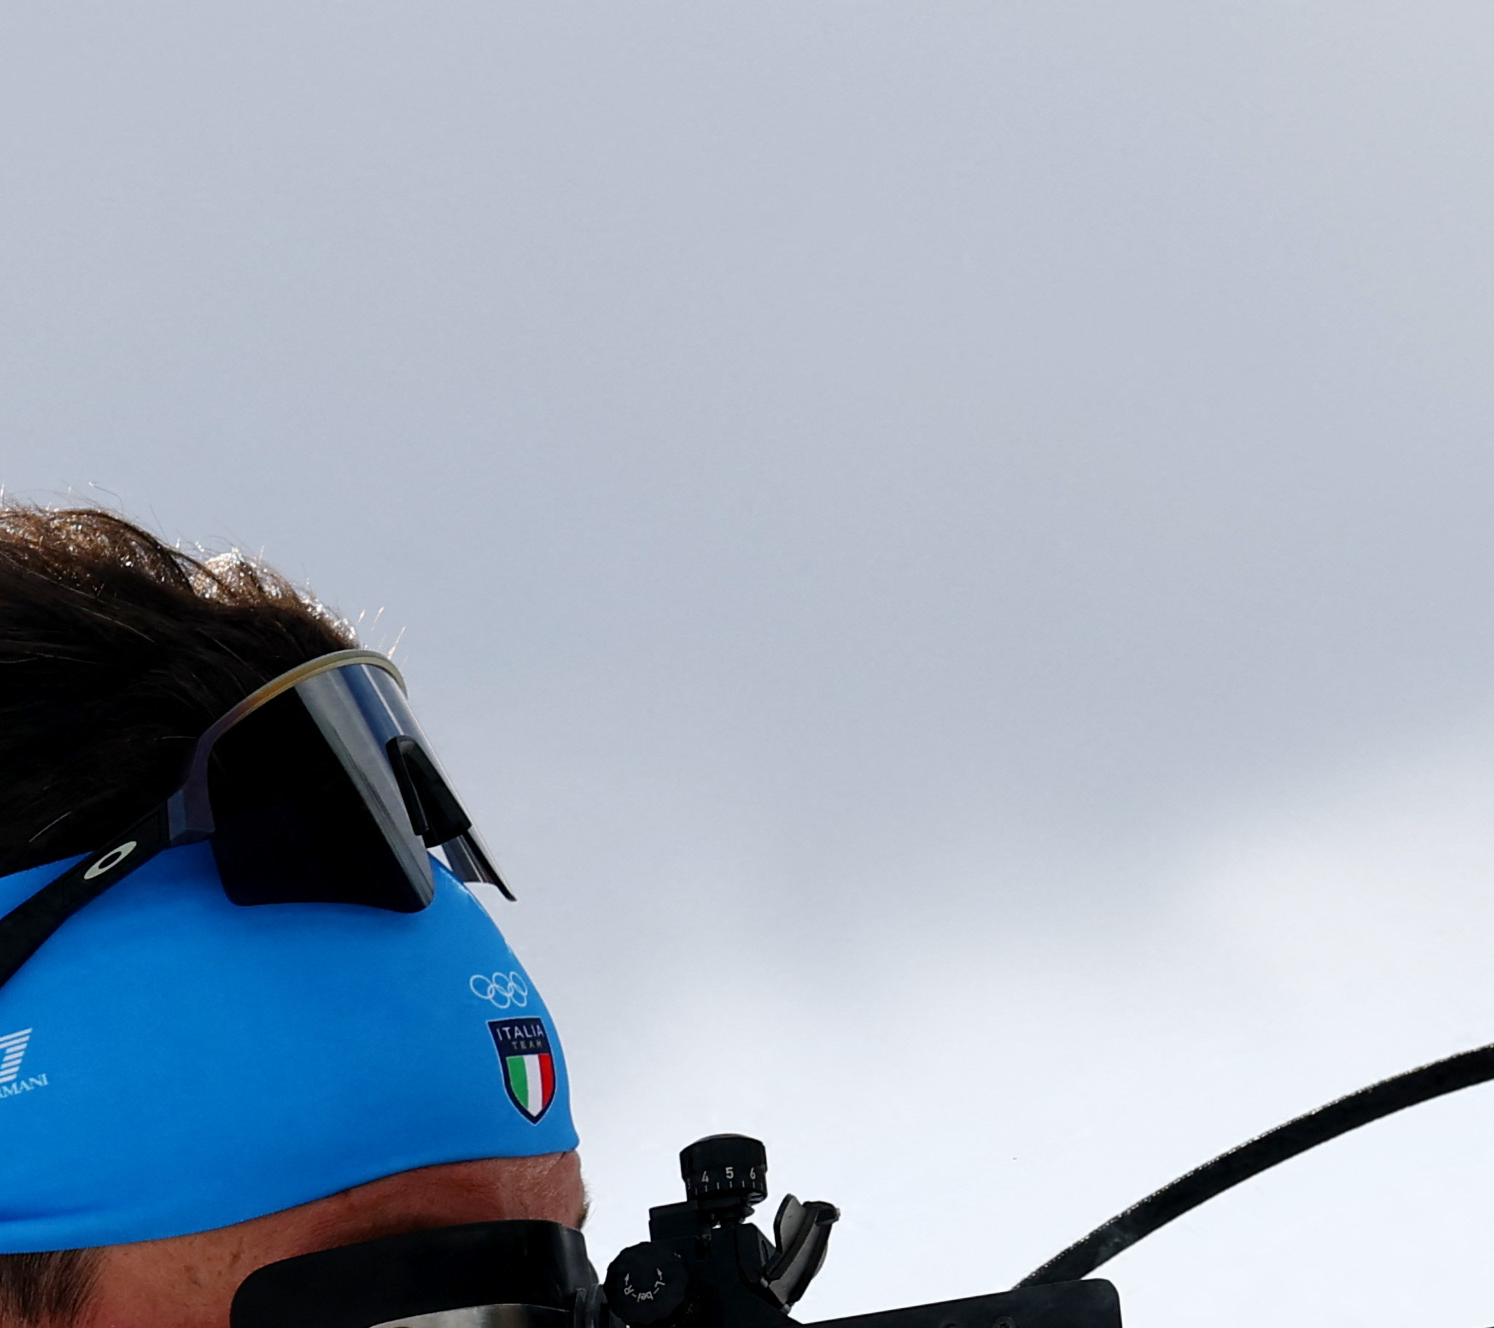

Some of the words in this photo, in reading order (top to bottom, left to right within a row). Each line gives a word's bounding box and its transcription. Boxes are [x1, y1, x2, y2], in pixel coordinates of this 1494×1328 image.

[496, 1024, 545, 1041] ITALIA
[511, 1040, 542, 1050] TEAM
[701, 1170, 710, 1183] 4
[725, 1166, 735, 1180] 5
[749, 1166, 756, 1180] 6
